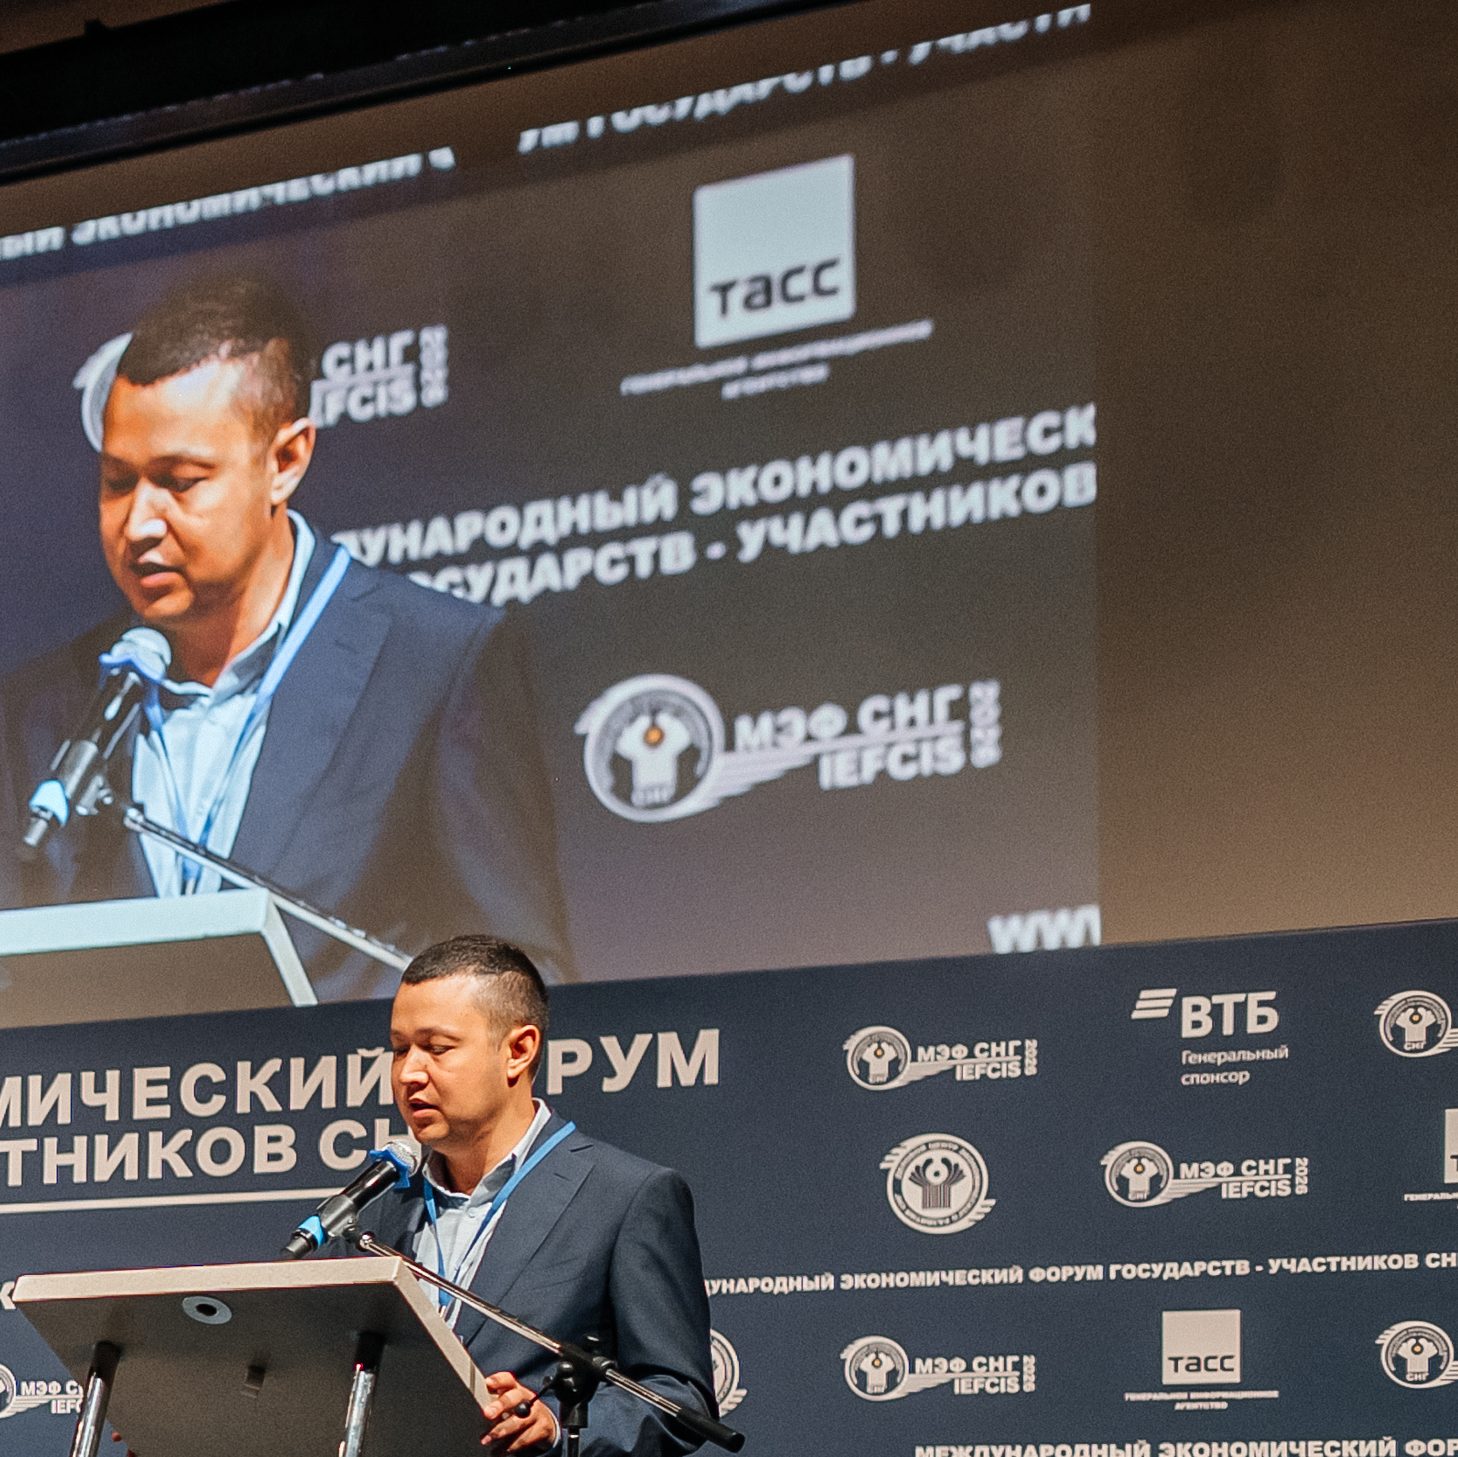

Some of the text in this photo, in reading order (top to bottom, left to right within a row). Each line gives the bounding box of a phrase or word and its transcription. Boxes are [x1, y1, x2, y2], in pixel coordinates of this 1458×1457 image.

[690, 402, 1097, 516] ЭКОНОМИЧЕСК
[734, 685, 962, 751] МЭФ СНГ
[818, 736, 965, 790] IEFCIS
[1181, 991, 1279, 1038] ВТБ
[917, 1041, 1022, 1062] МЭФ СНГ
[1182, 1045, 1289, 1065] Генеральный
[547, 1029, 720, 1096] РУМ
[955, 1061, 1021, 1081] IEFCIS
[1181, 1071, 1250, 1086] спонсор
[1180, 1158, 1292, 1180] МЭФ СНГ
[1221, 1179, 1292, 1199] IEFCIS
[703, 1252, 1458, 1296] УНАРОДНЫЙ ЭКОНОМИЧЕСКИЙ ФОРУМ ГОСУДАРСТВ УЧАСТНИКОВ СН
[914, 1355, 1020, 1374] МЭФ СНГ
[20, 1381, 62, 1396] МЭФ
[954, 1376, 1020, 1394] IEFCIS
[1404, 1439, 1458, 1457] ФОР
